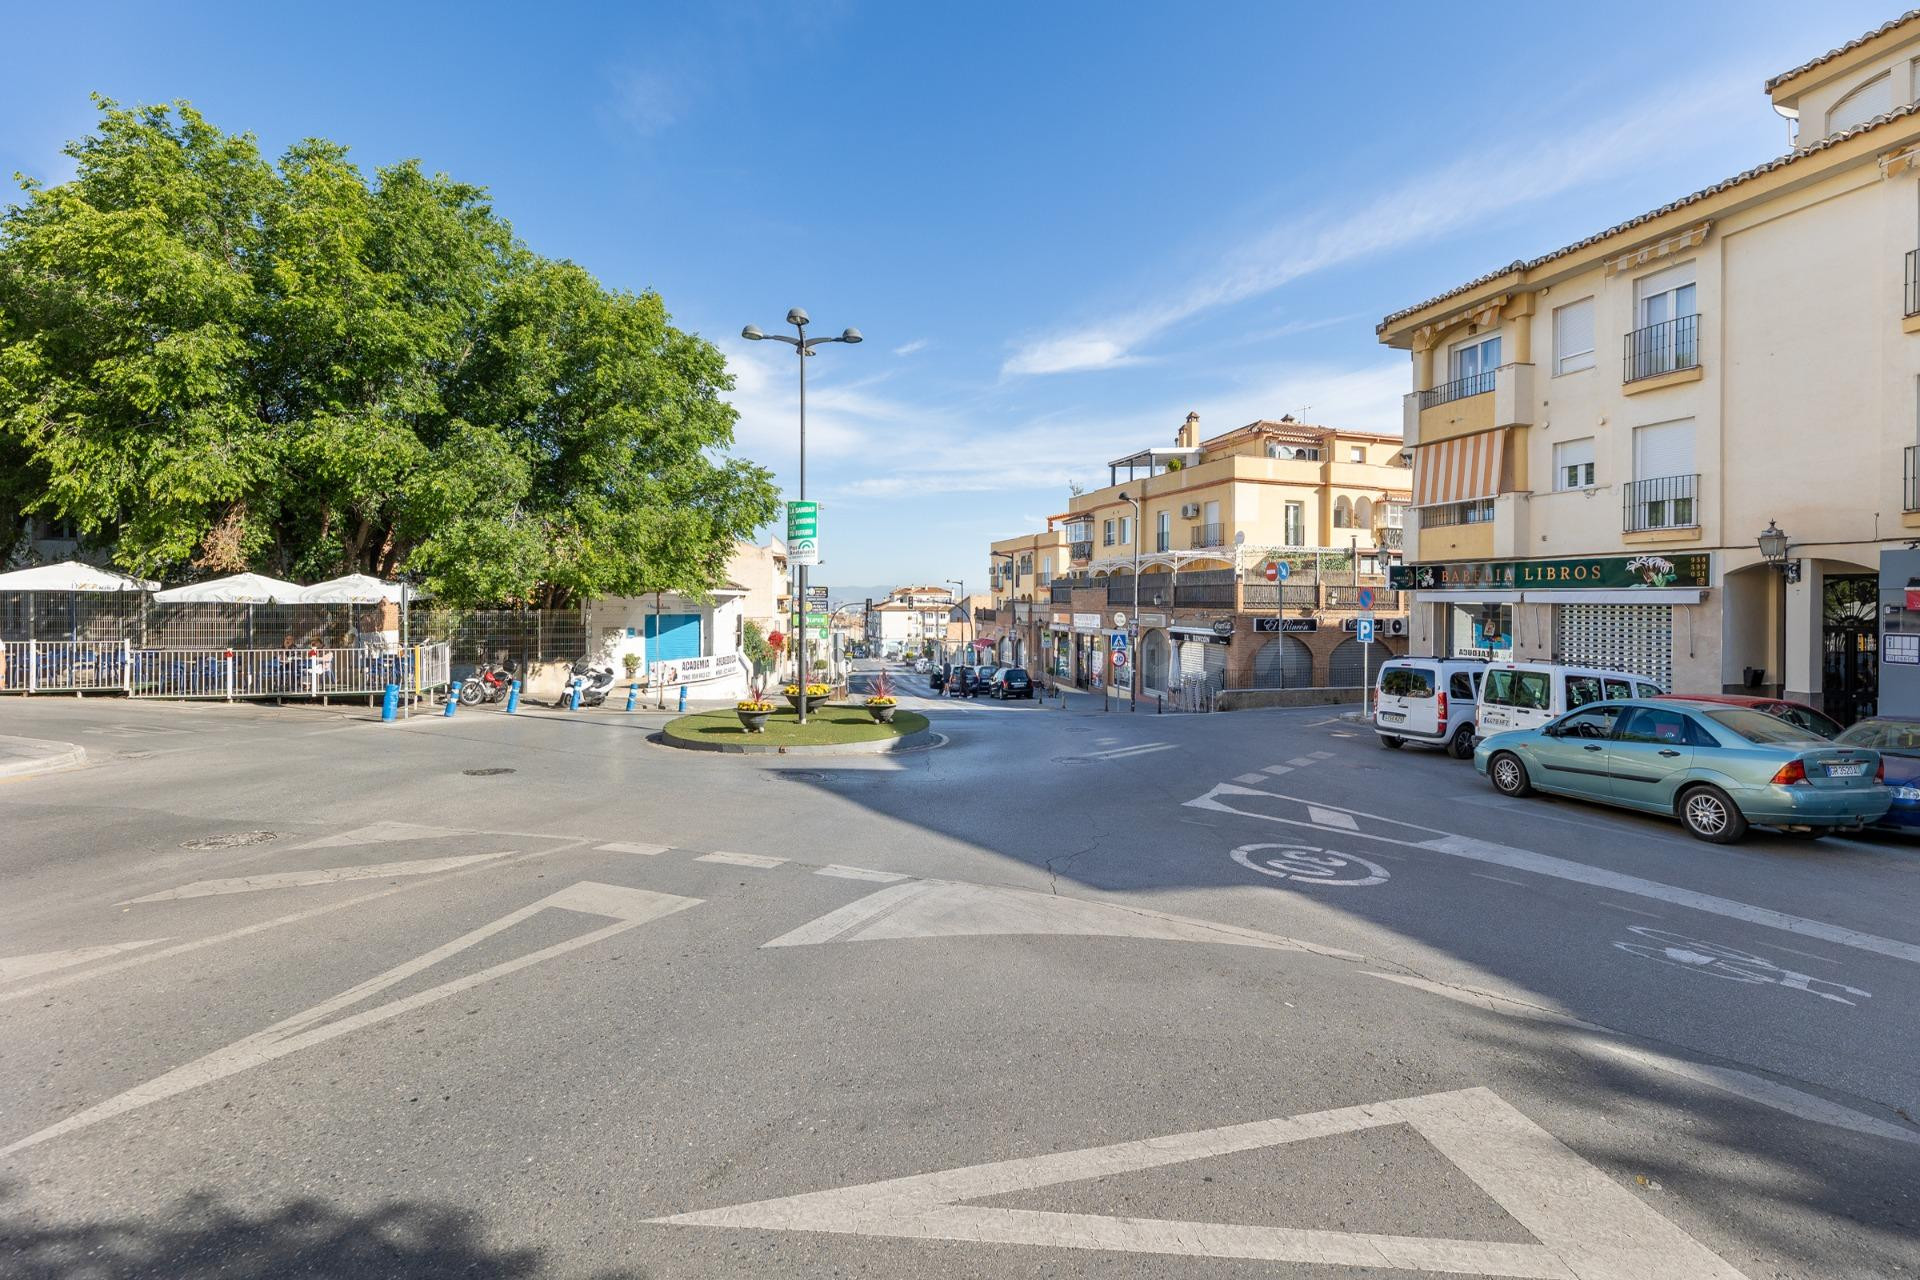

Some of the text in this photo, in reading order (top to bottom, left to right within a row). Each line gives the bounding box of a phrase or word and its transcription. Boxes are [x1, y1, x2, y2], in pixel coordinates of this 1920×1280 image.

[1442, 565, 1601, 582] BABELIA LIBROS
[1264, 619, 1309, 631] El Rincón
[1361, 620, 1371, 640] P
[1184, 633, 1190, 641] EL
[682, 659, 710, 671] ACADEMIA
